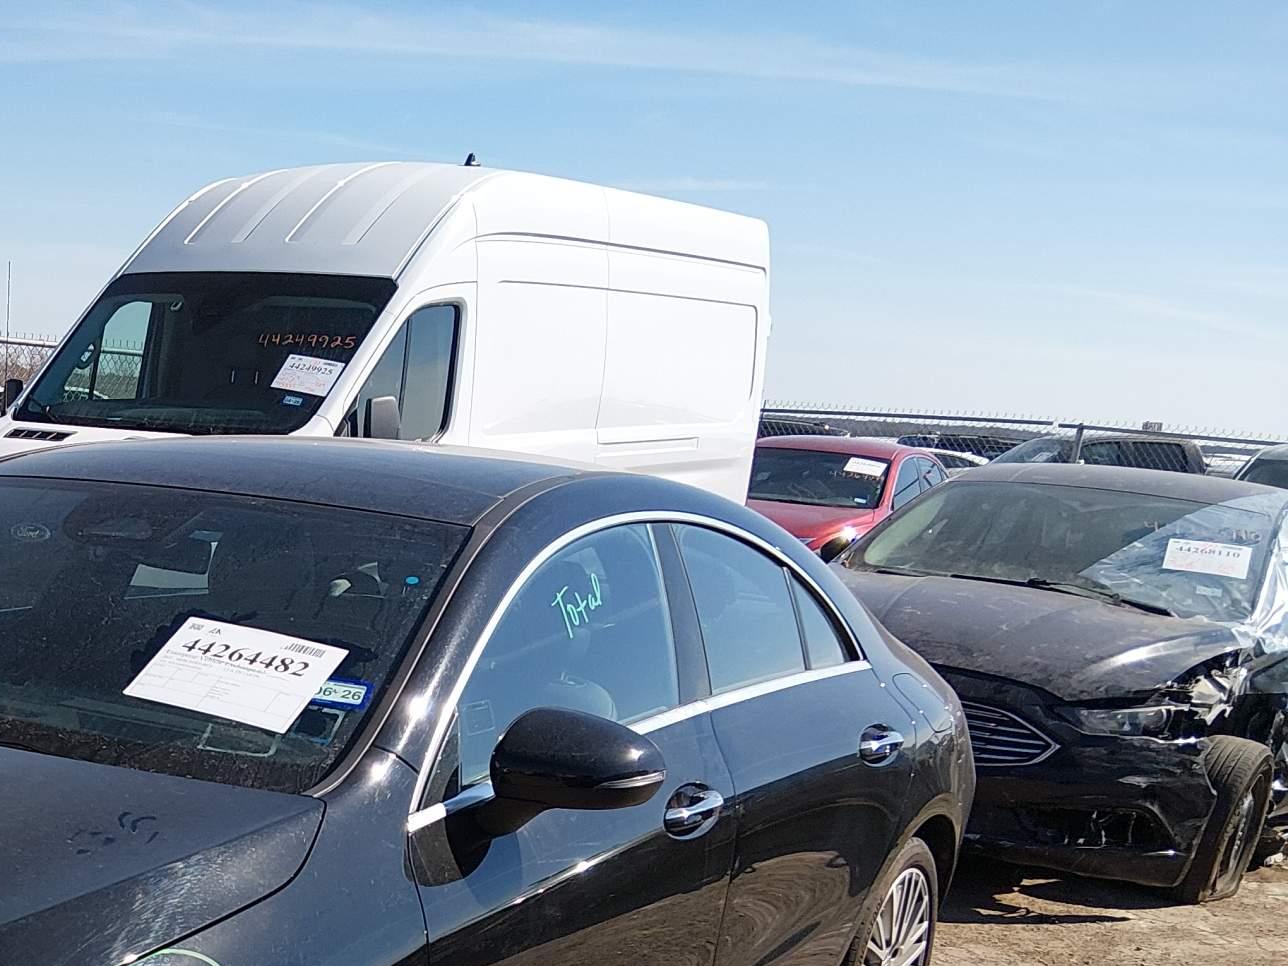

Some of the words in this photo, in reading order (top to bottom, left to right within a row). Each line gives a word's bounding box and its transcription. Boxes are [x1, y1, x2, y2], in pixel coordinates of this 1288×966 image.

[258, 334, 356, 348] 44249925
[289, 362, 333, 376] 44249925
[1175, 545, 1241, 559] 44268110
[551, 572, 602, 639] Total
[181, 637, 311, 678] 44264482
[341, 689, 363, 701] 26
